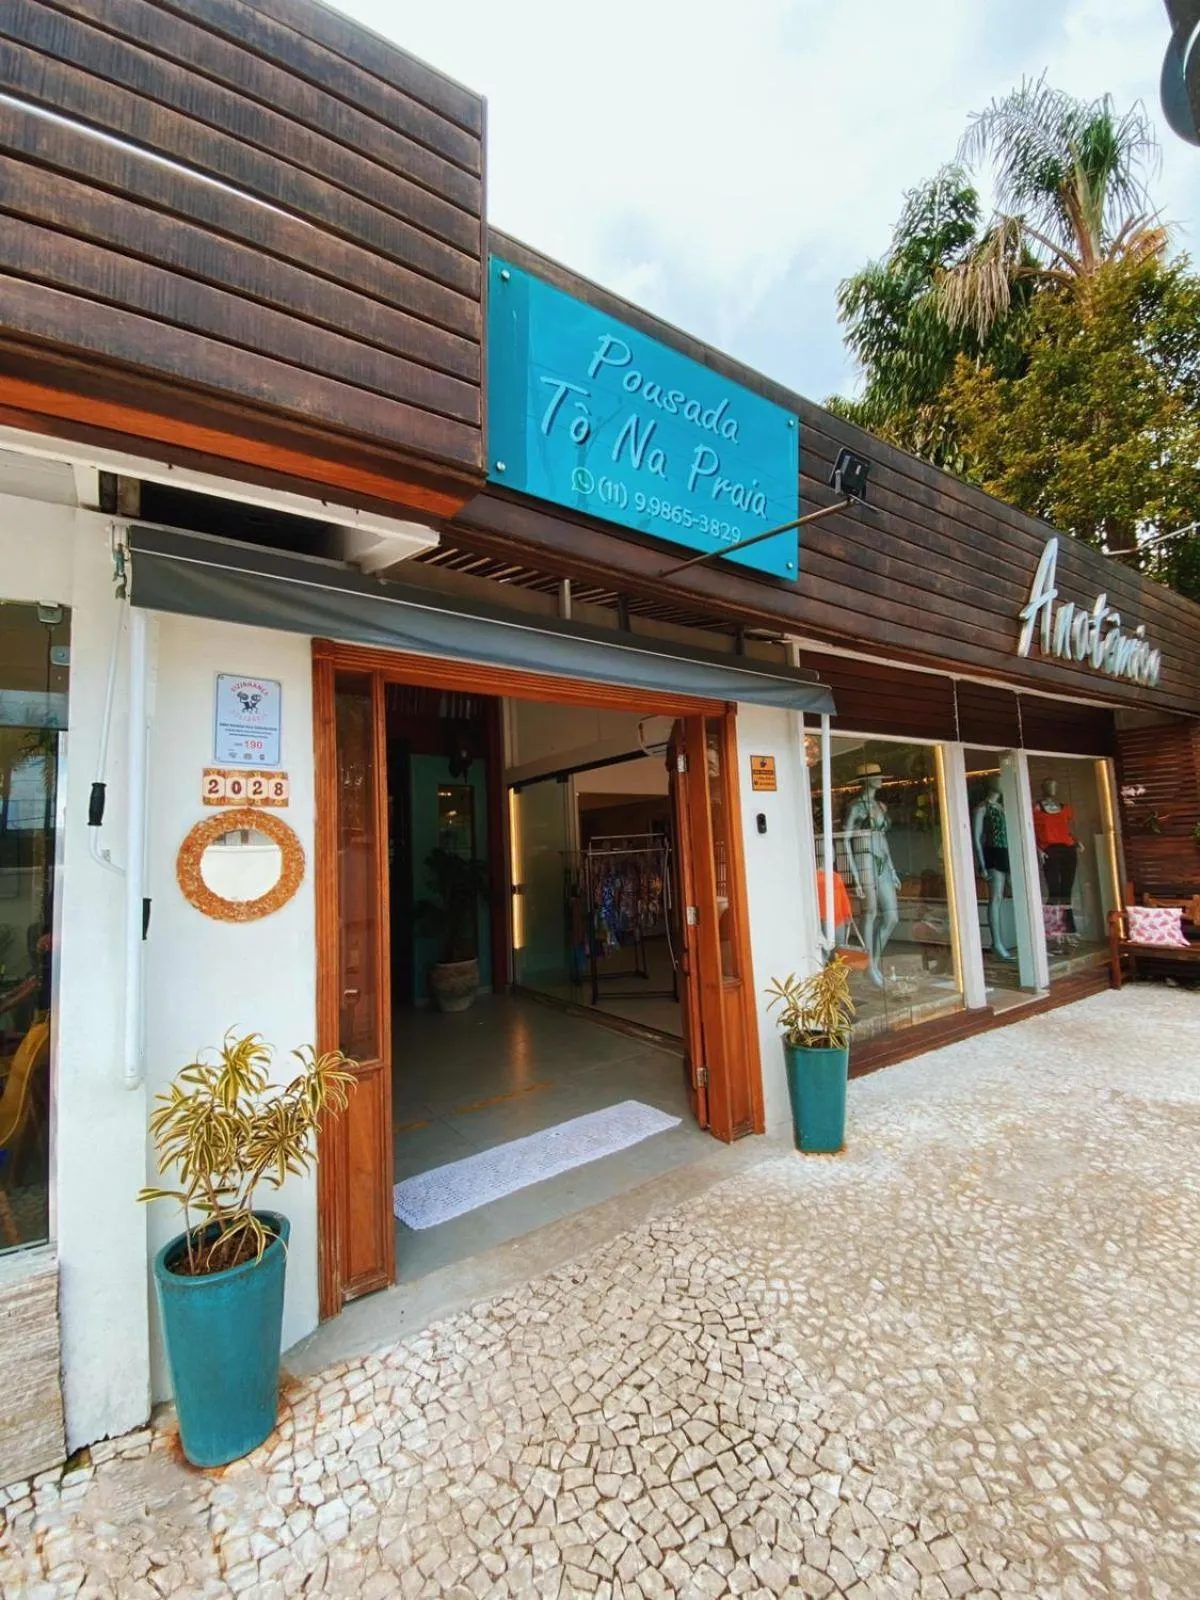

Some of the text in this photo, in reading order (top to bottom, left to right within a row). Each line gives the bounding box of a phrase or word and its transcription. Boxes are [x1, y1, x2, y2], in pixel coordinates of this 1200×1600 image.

[587, 333, 740, 443] Pousada
[598, 475, 627, 509] (11)
[612, 413, 667, 479] Na
[688, 444, 768, 519] Praia
[207, 779, 284, 797] 2028
